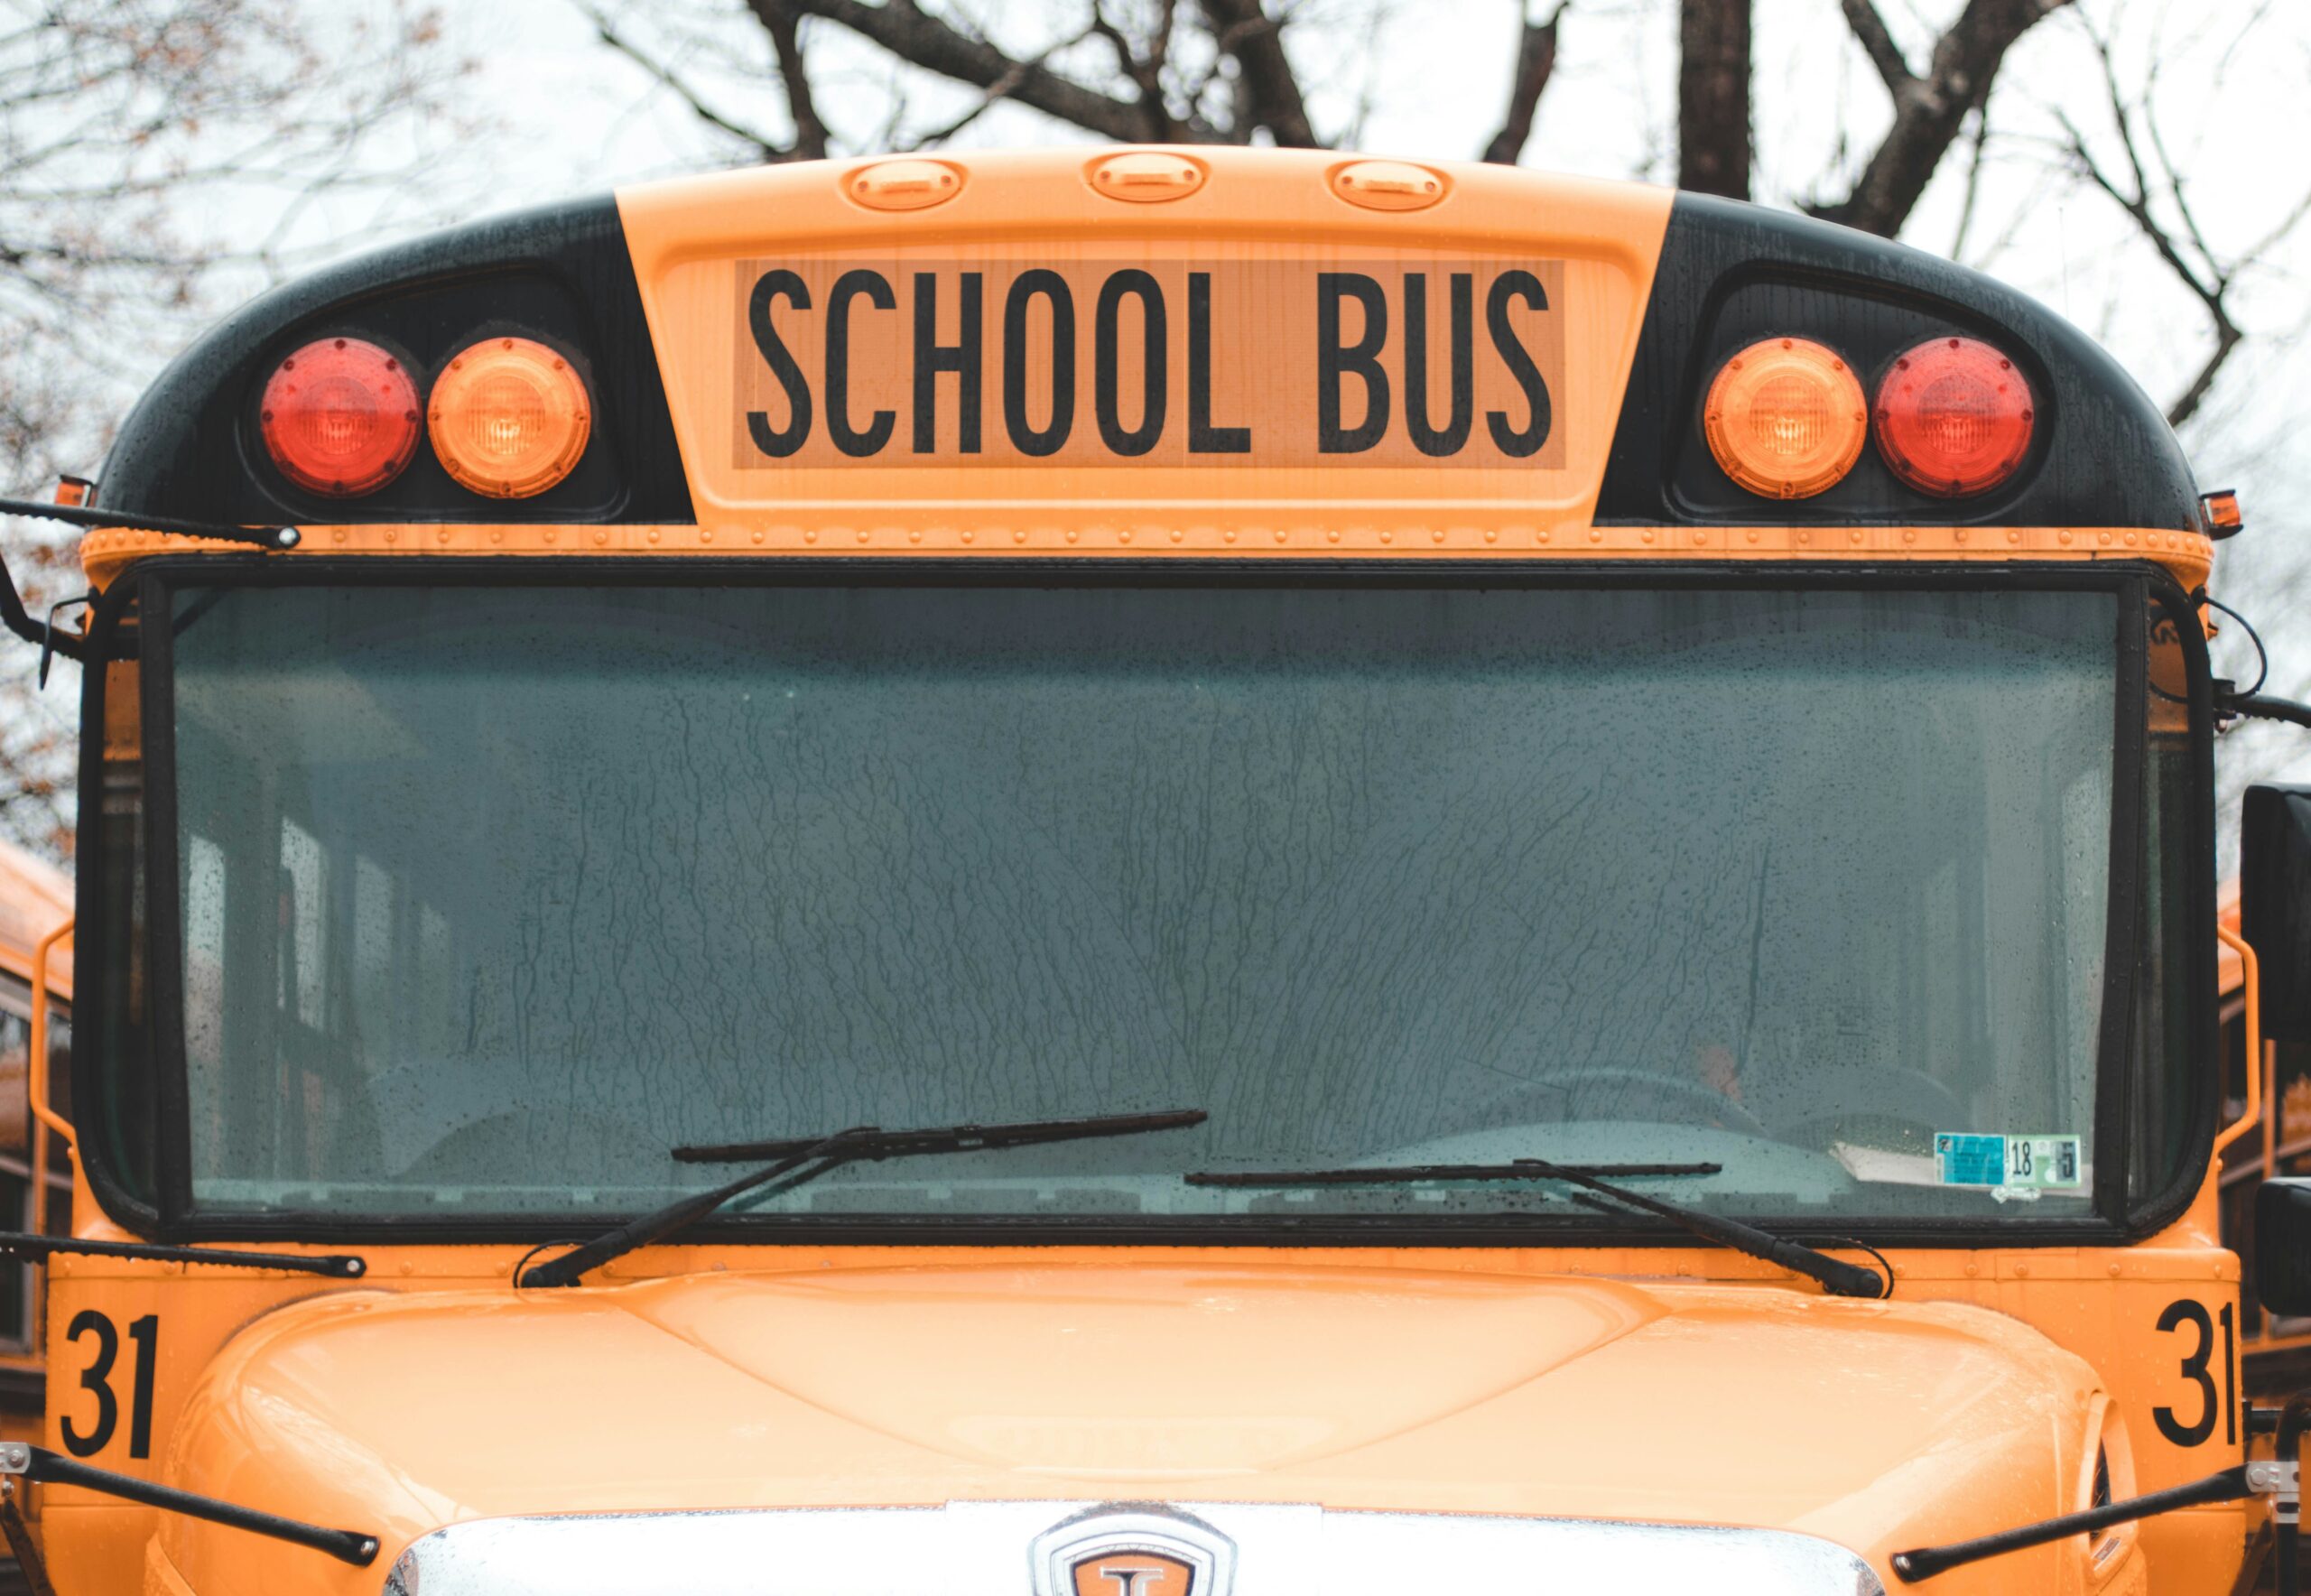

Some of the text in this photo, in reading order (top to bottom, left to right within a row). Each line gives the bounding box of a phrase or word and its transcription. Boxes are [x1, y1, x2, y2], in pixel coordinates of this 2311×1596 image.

[747, 269, 1551, 458] SCHOOL BUS
[2014, 1142, 2030, 1175] 18
[60, 1310, 158, 1459] 31
[2153, 1300, 2235, 1447] 31
